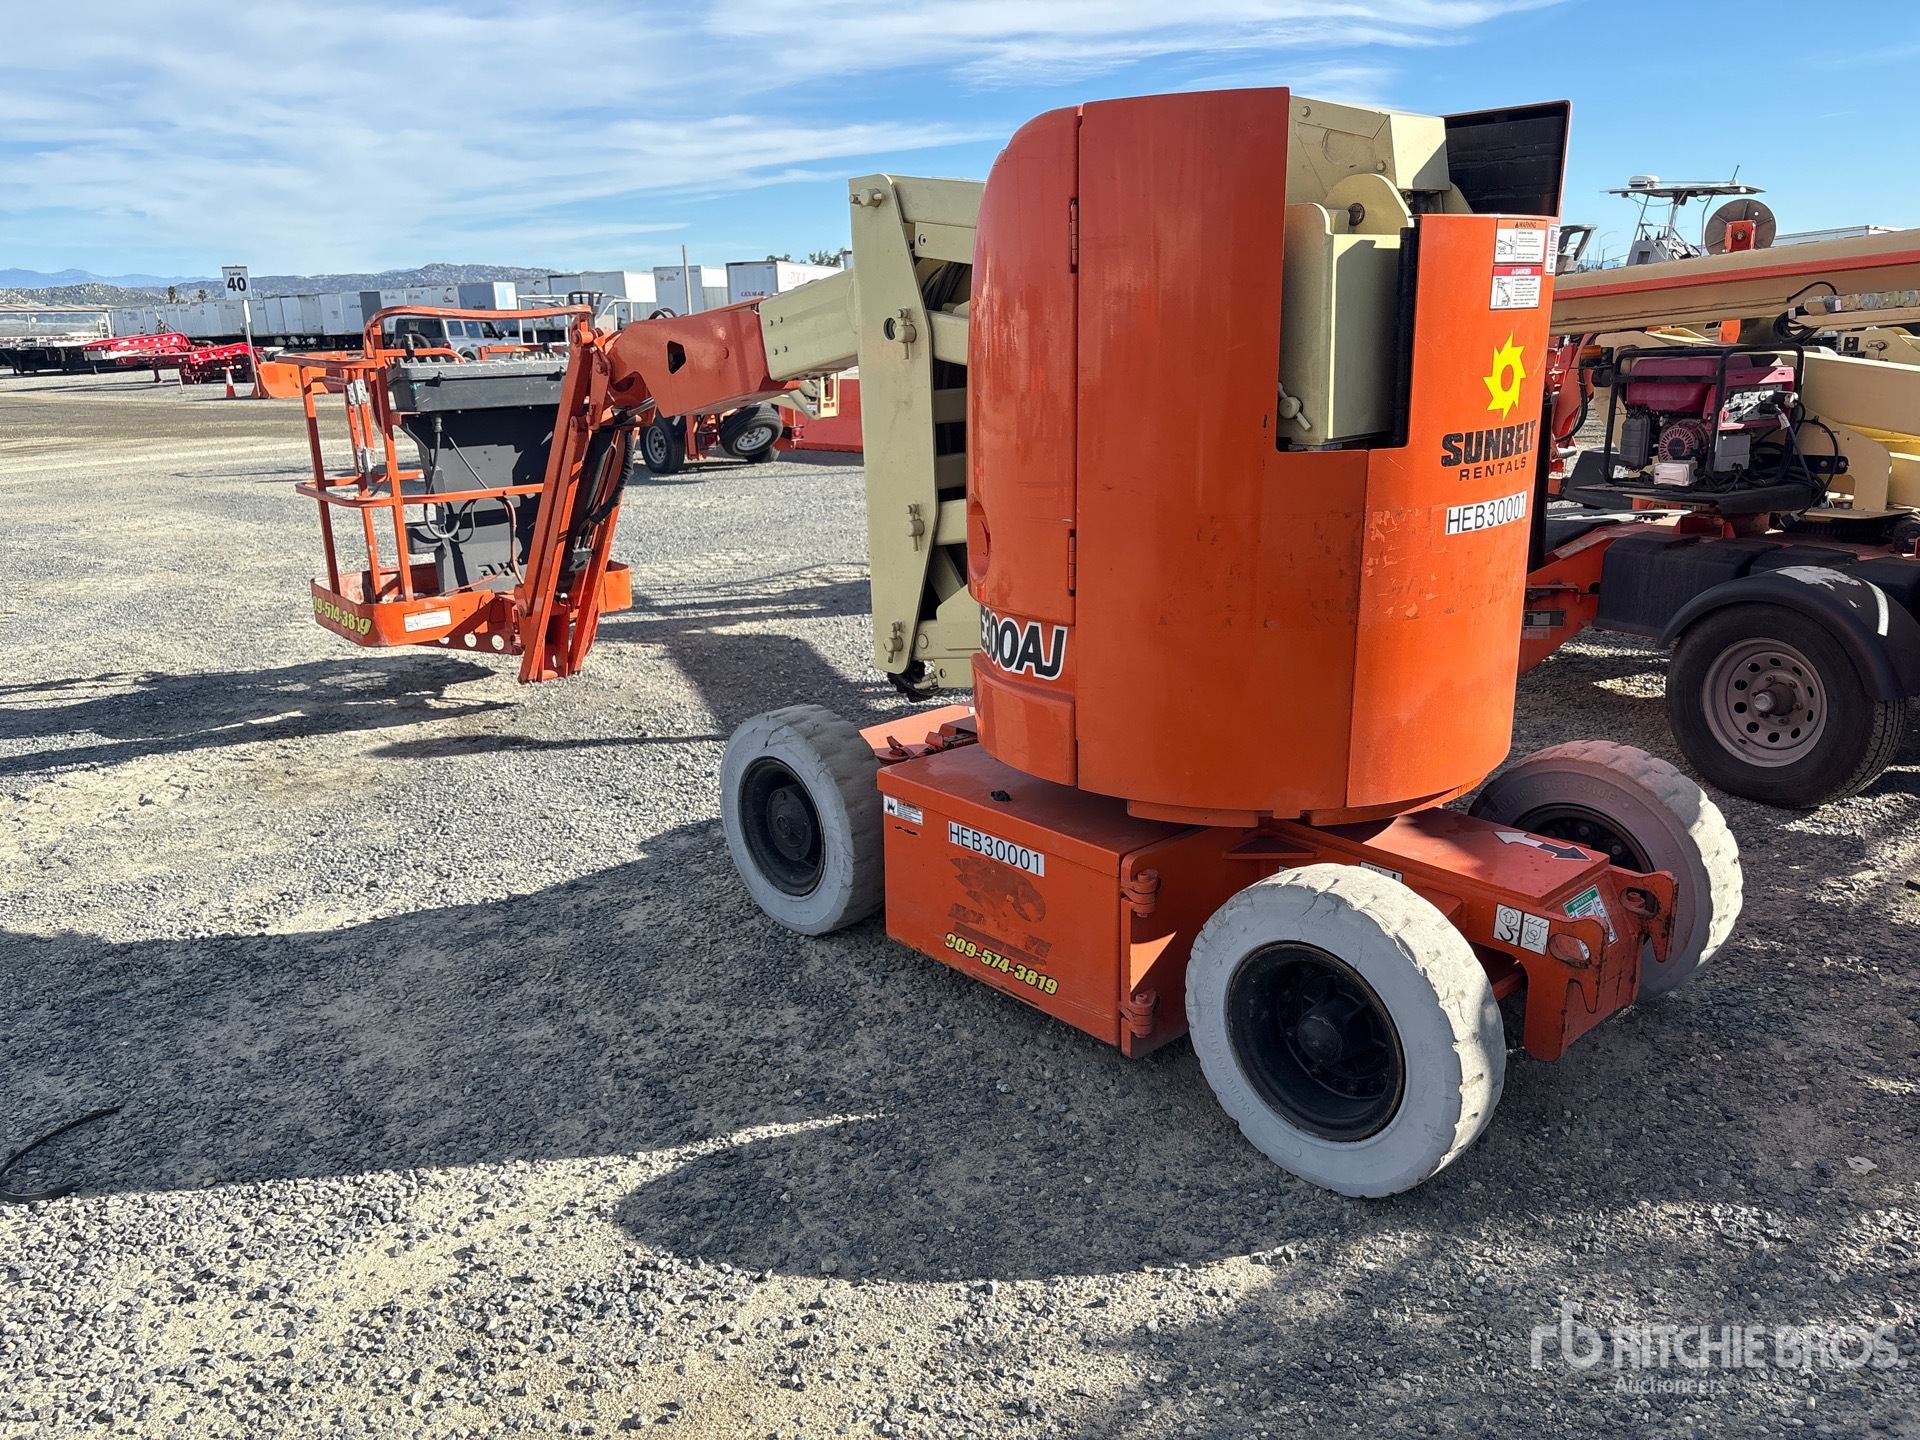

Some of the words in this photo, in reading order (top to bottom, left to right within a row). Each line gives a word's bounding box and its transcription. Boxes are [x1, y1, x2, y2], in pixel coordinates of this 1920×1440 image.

[227, 277, 247, 292] 40
[1441, 419, 1537, 468] SUNBELT
[1459, 456, 1527, 481] RENTALS
[1446, 493, 1526, 534] HEB30001
[312, 594, 372, 636] 09-574-3819
[949, 822, 1041, 875] HEB30001
[1571, 893, 1593, 910] IMPORTANT
